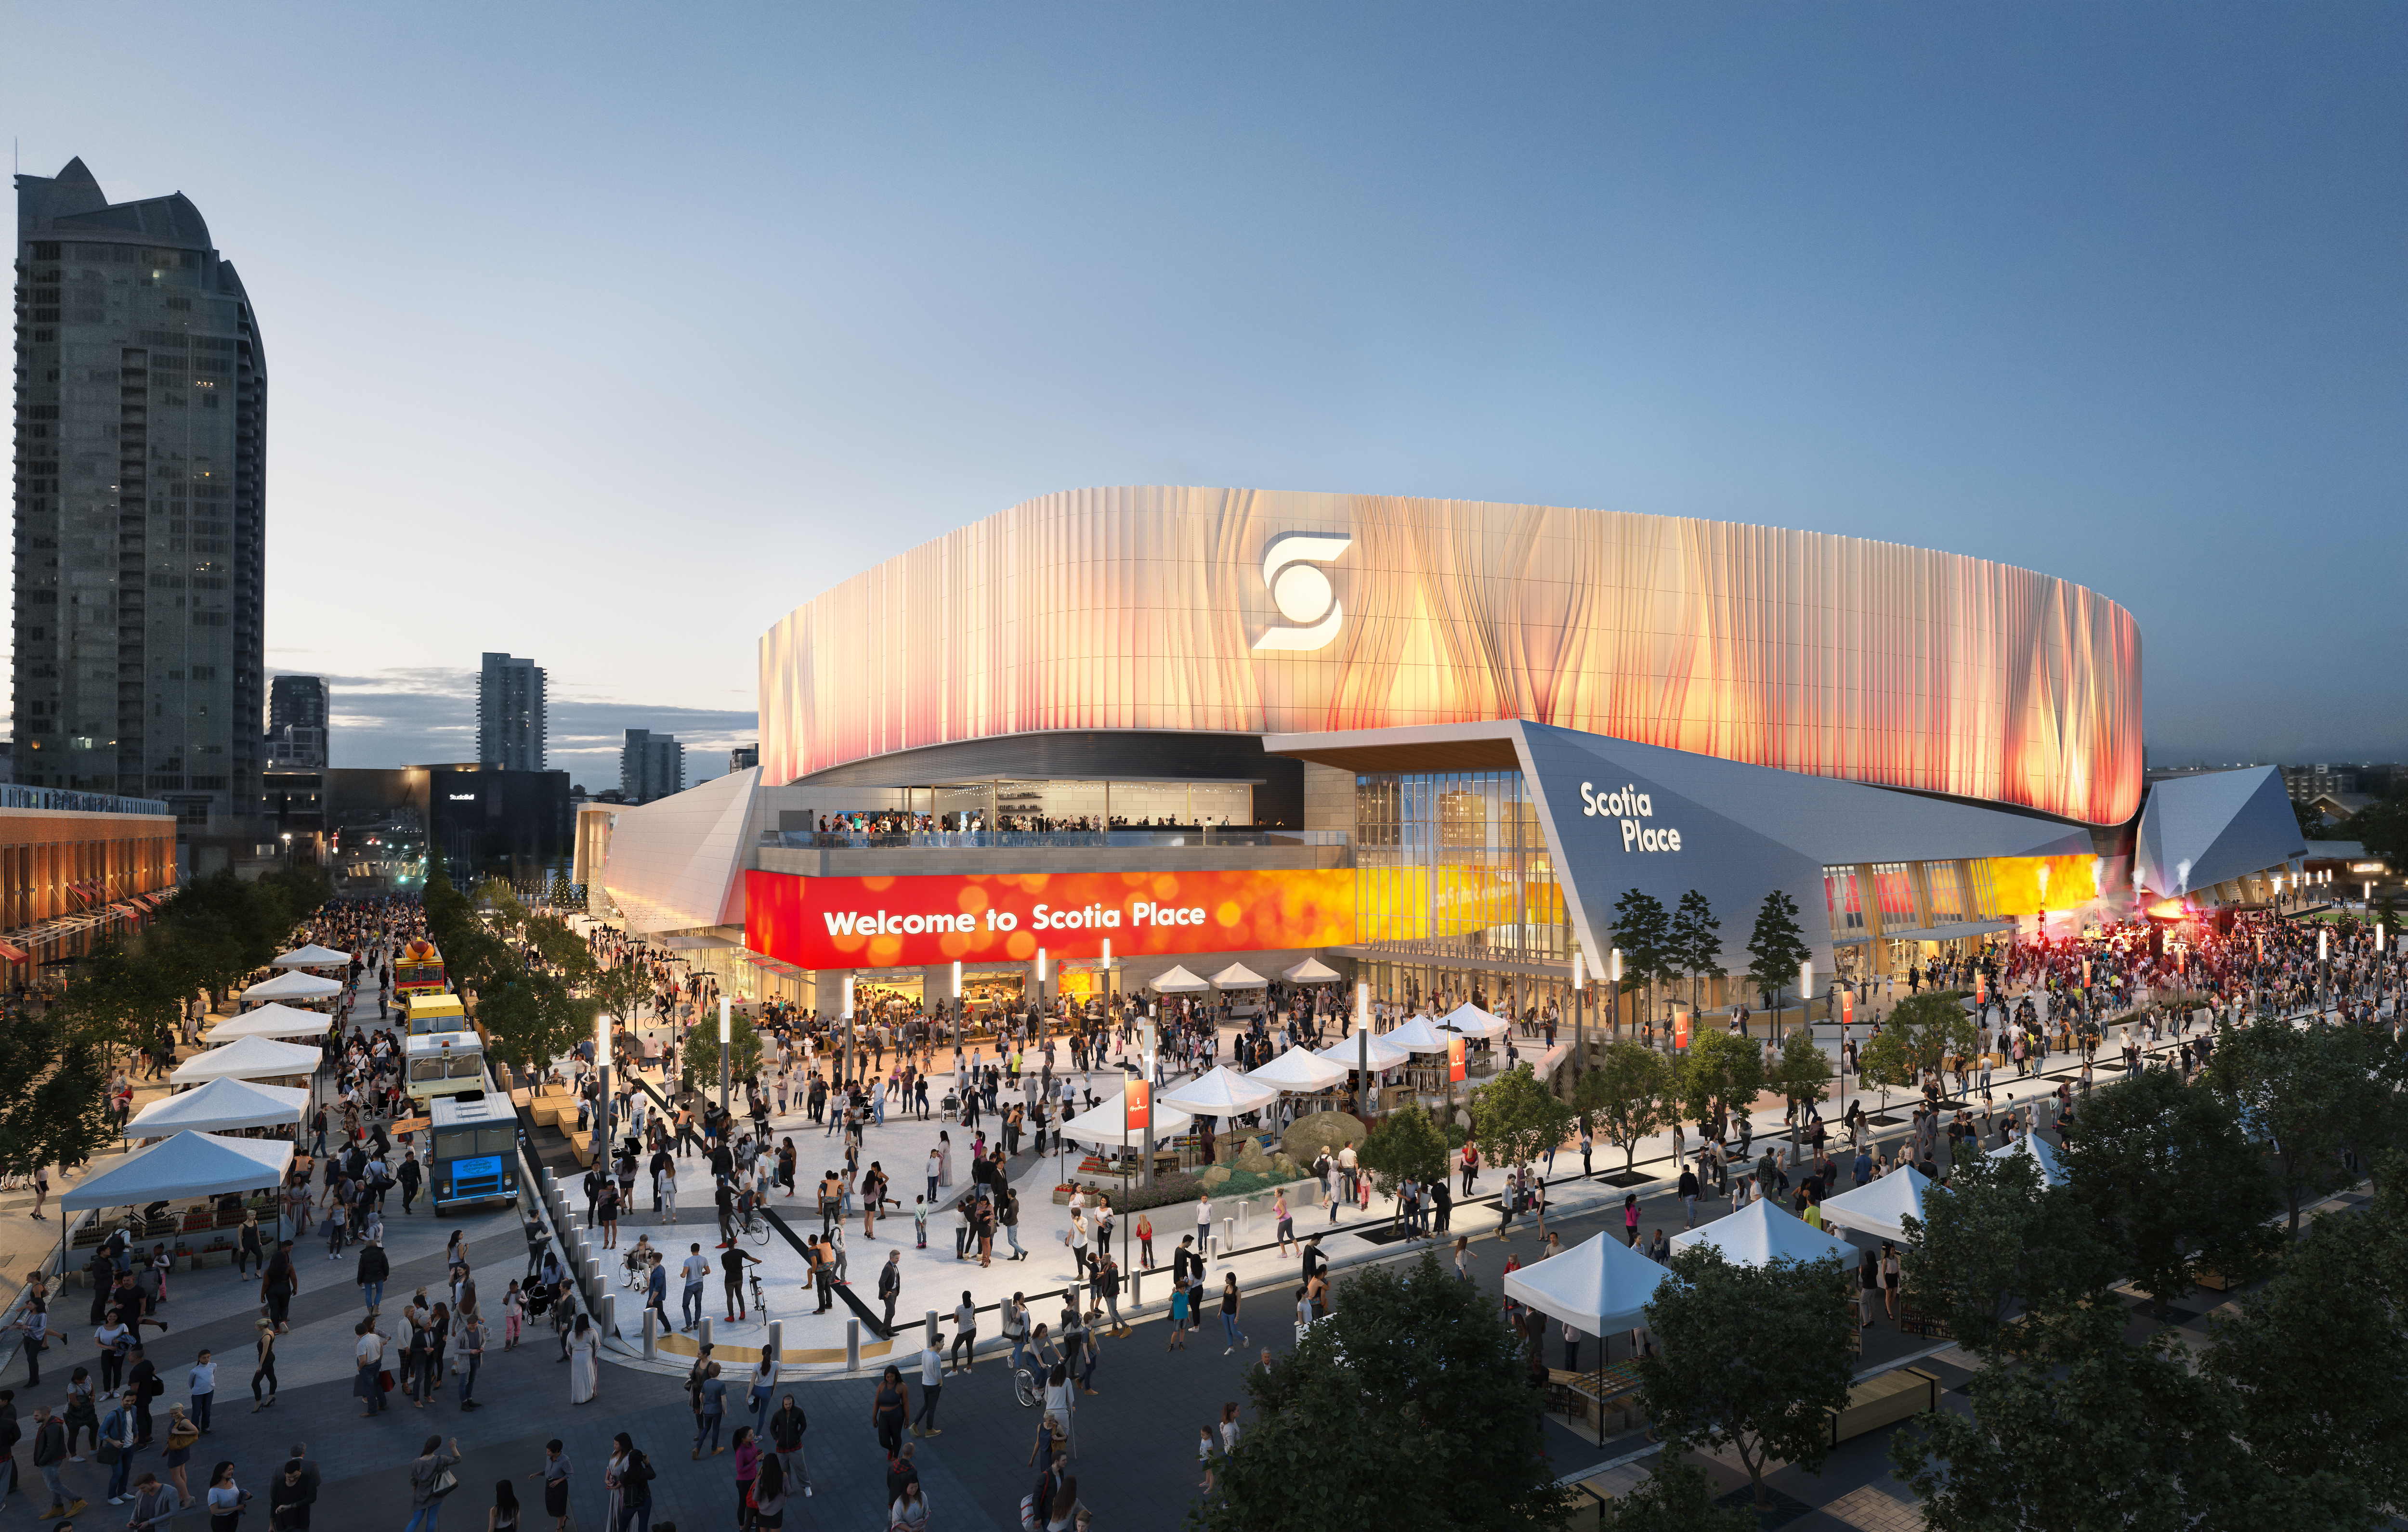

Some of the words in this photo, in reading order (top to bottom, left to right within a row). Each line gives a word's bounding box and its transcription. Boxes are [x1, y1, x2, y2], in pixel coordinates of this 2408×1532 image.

[1580, 782, 1652, 817] Scotia
[1621, 819, 1681, 852] Place
[823, 909, 976, 936] Welcome
[986, 908, 1018, 931] to
[1032, 903, 1120, 930] Scotia
[1133, 901, 1206, 926] Place
[1364, 937, 1443, 957] SOUTHWEST
[1447, 944, 1492, 961] ENTRY
[1495, 947, 1532, 965] GATE
[1537, 950, 1544, 966] 1
